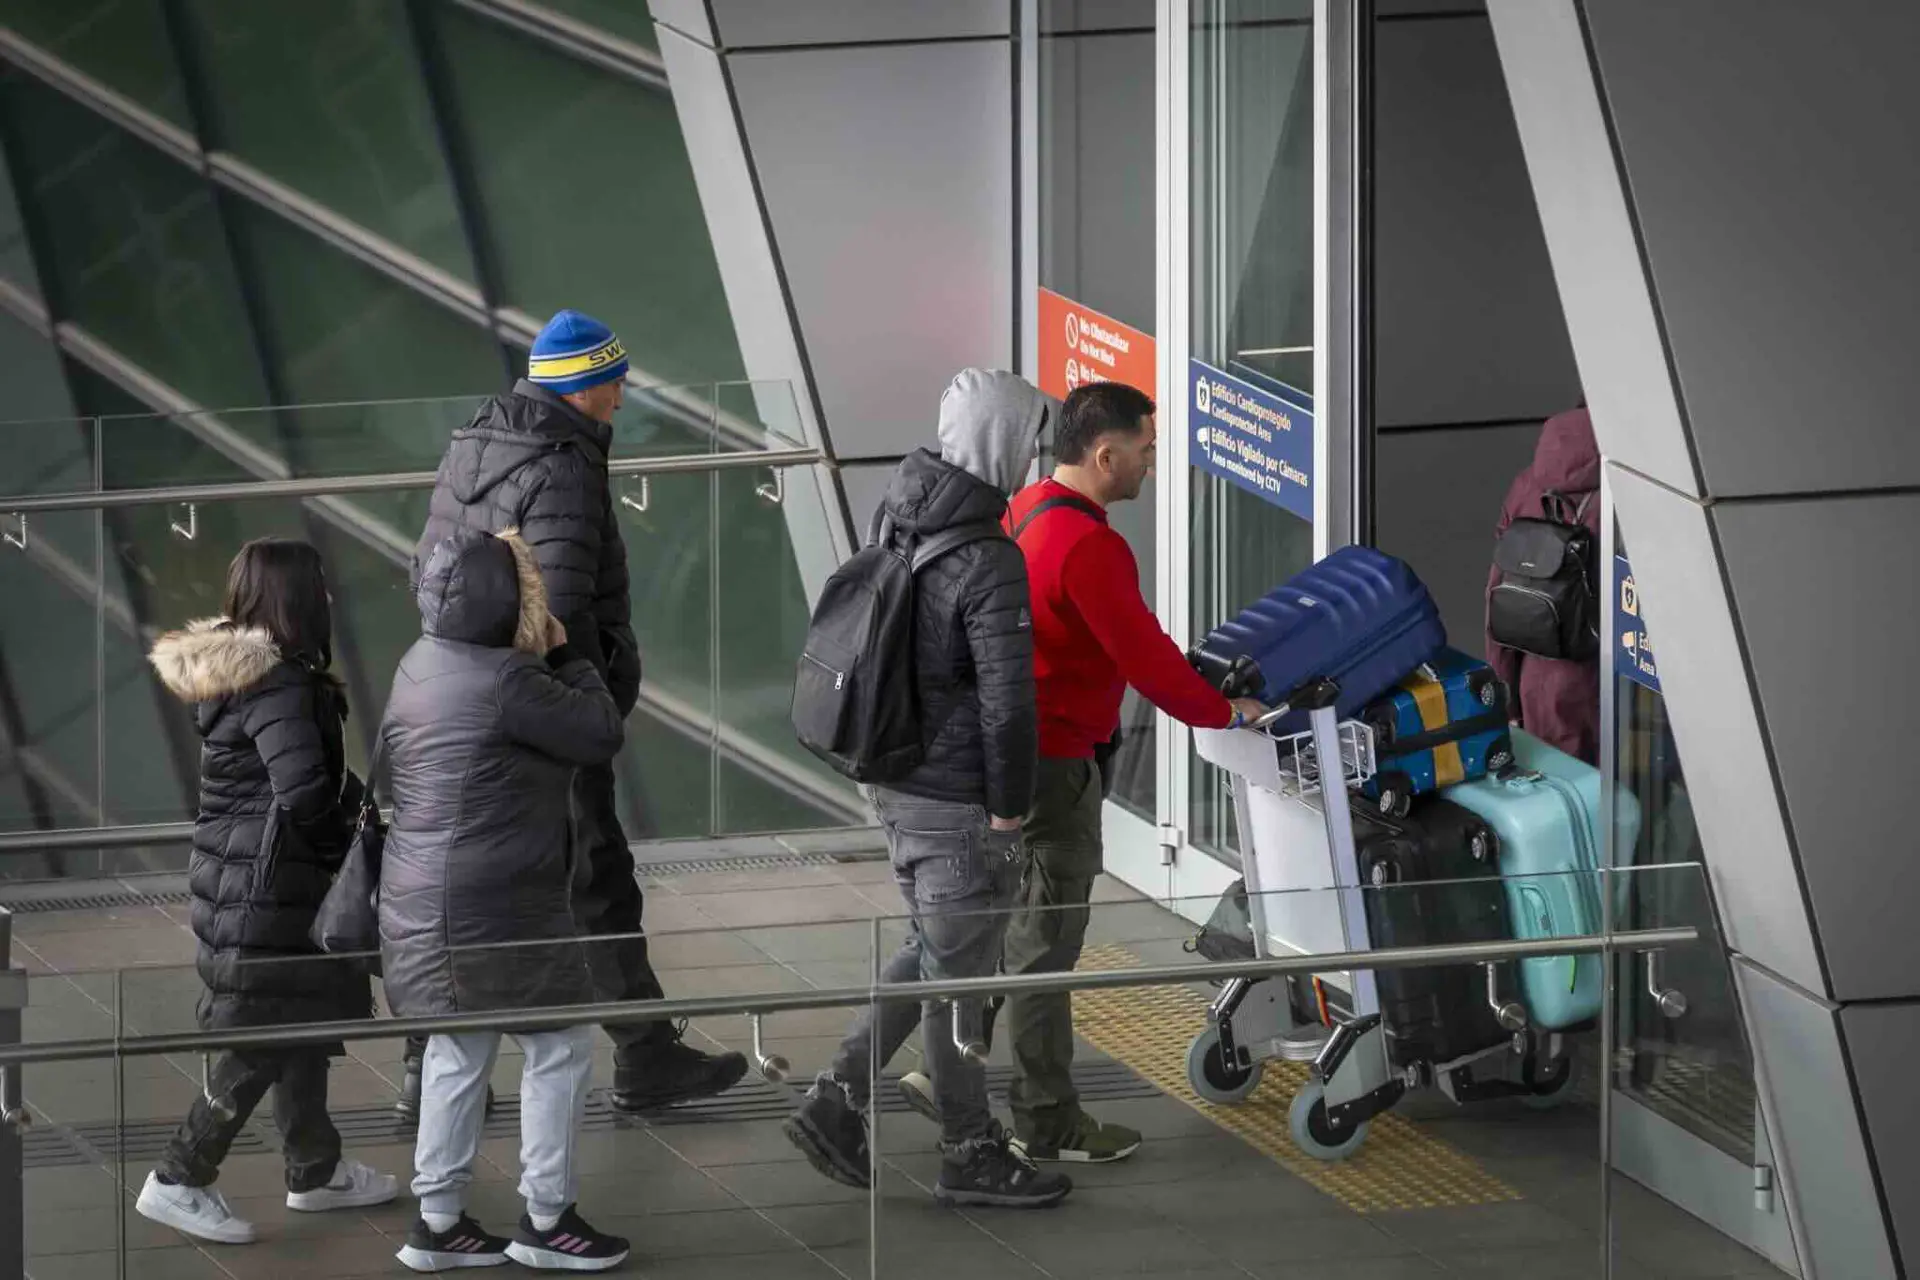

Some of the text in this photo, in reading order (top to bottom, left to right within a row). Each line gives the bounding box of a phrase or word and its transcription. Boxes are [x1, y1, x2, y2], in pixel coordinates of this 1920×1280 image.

[1211, 381, 1291, 431] Edificio Cardioprotegido
[1212, 427, 1236, 452] Edificio
[1237, 439, 1265, 465] Vigilado
[1266, 456, 1278, 473] por
[1257, 470, 1265, 489] by
[1265, 476, 1280, 494] CCTV
